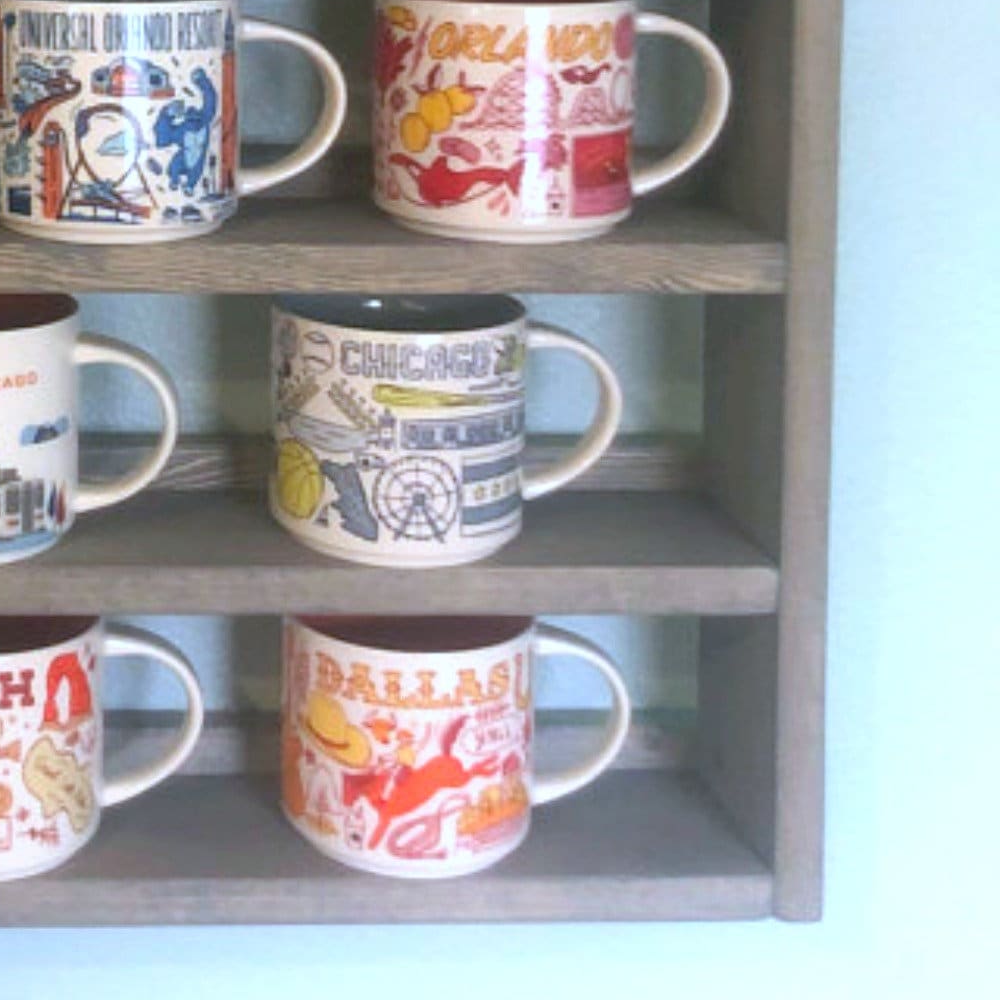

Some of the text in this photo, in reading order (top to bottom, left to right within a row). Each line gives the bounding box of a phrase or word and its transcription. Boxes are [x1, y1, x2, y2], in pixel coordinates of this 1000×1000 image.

[427, 21, 614, 63] ORLANDO
[339, 338, 489, 381] CHICAGO
[315, 652, 511, 709] DALLAS
